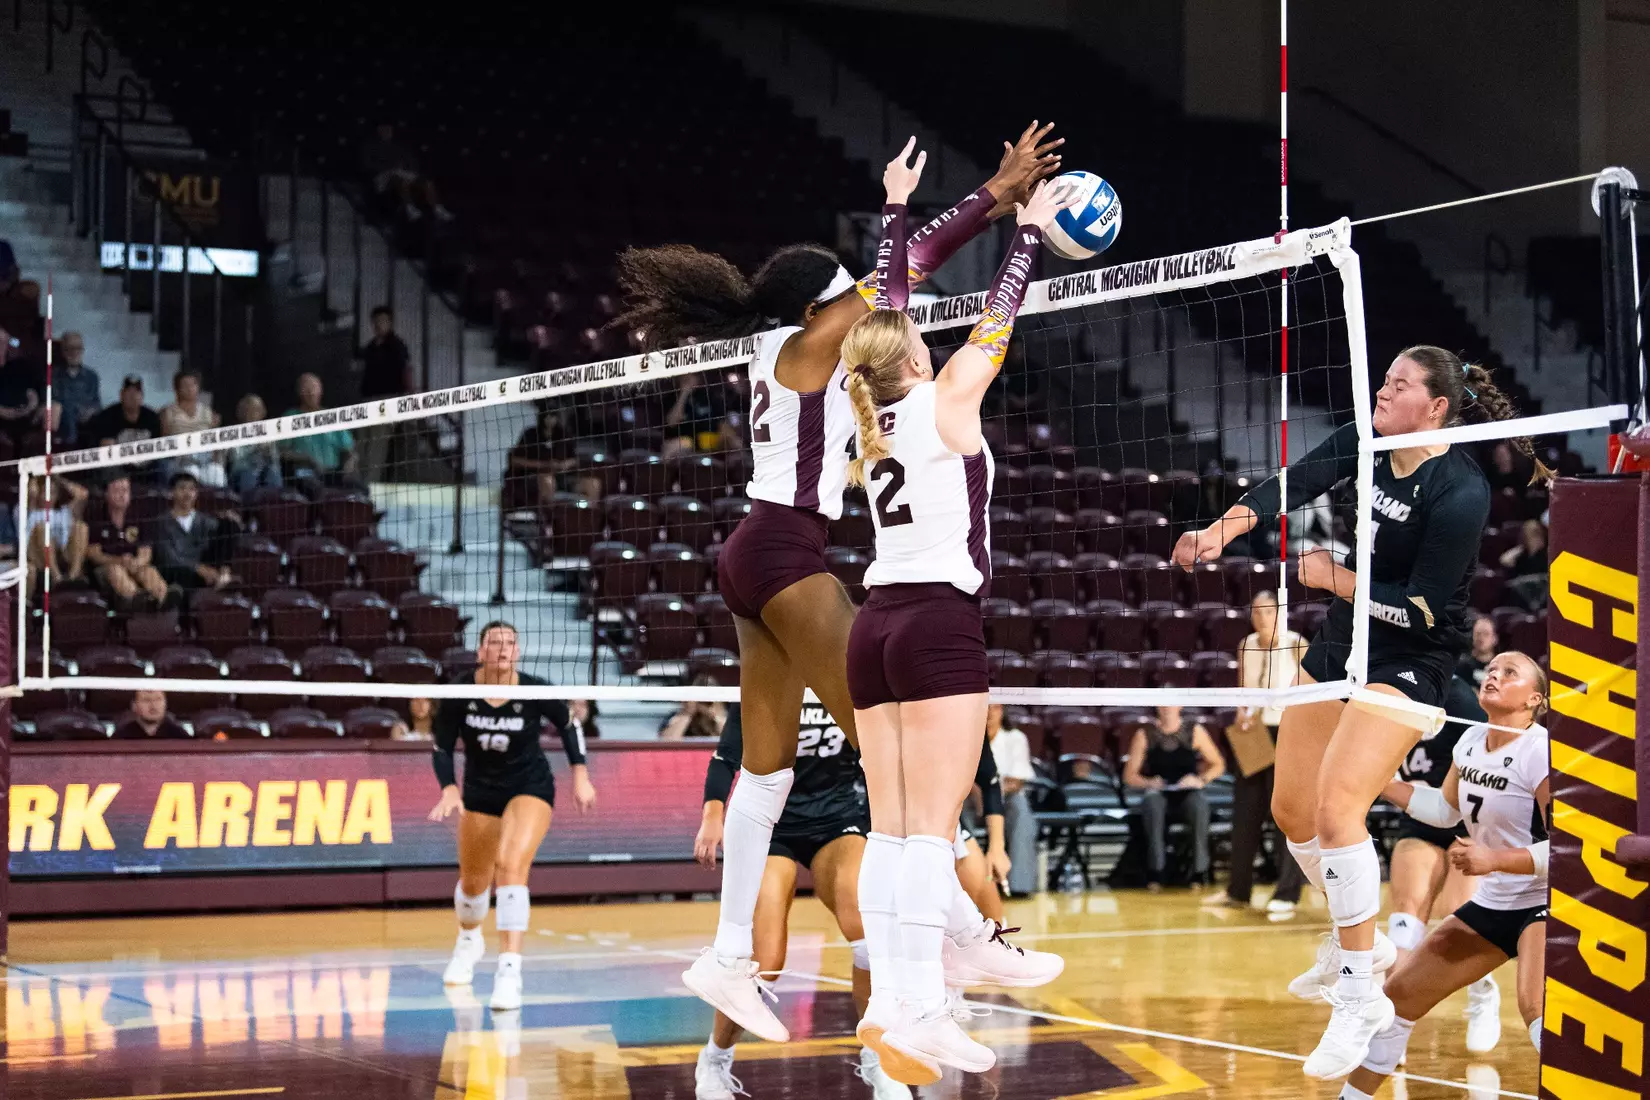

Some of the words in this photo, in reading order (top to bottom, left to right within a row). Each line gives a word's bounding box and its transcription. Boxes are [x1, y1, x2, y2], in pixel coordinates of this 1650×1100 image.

[1315, 228, 1334, 239] Senoh
[989, 251, 1032, 327] CHIPPEWAS
[1048, 273, 1097, 301] CENTRAL
[1101, 259, 1160, 292] MICHIGAN
[1163, 246, 1237, 281] VOLLEYBALL
[665, 349, 697, 368] CENTRAL
[700, 339, 739, 363] MICHIGAN
[519, 376, 547, 393] CENTRAL
[550, 369, 582, 388] MICHIGAN
[584, 360, 626, 383] VOLLEYBALL
[397, 397, 420, 413] CENTRAL
[422, 391, 449, 409] MICHIGAN
[452, 384, 486, 405] VOLLEYBALL
[870, 457, 914, 528] 2
[465, 714, 524, 731] OAKLAND
[796, 726, 846, 758] 23
[144, 779, 393, 848] ARENA
[1467, 793, 1484, 824] 7
